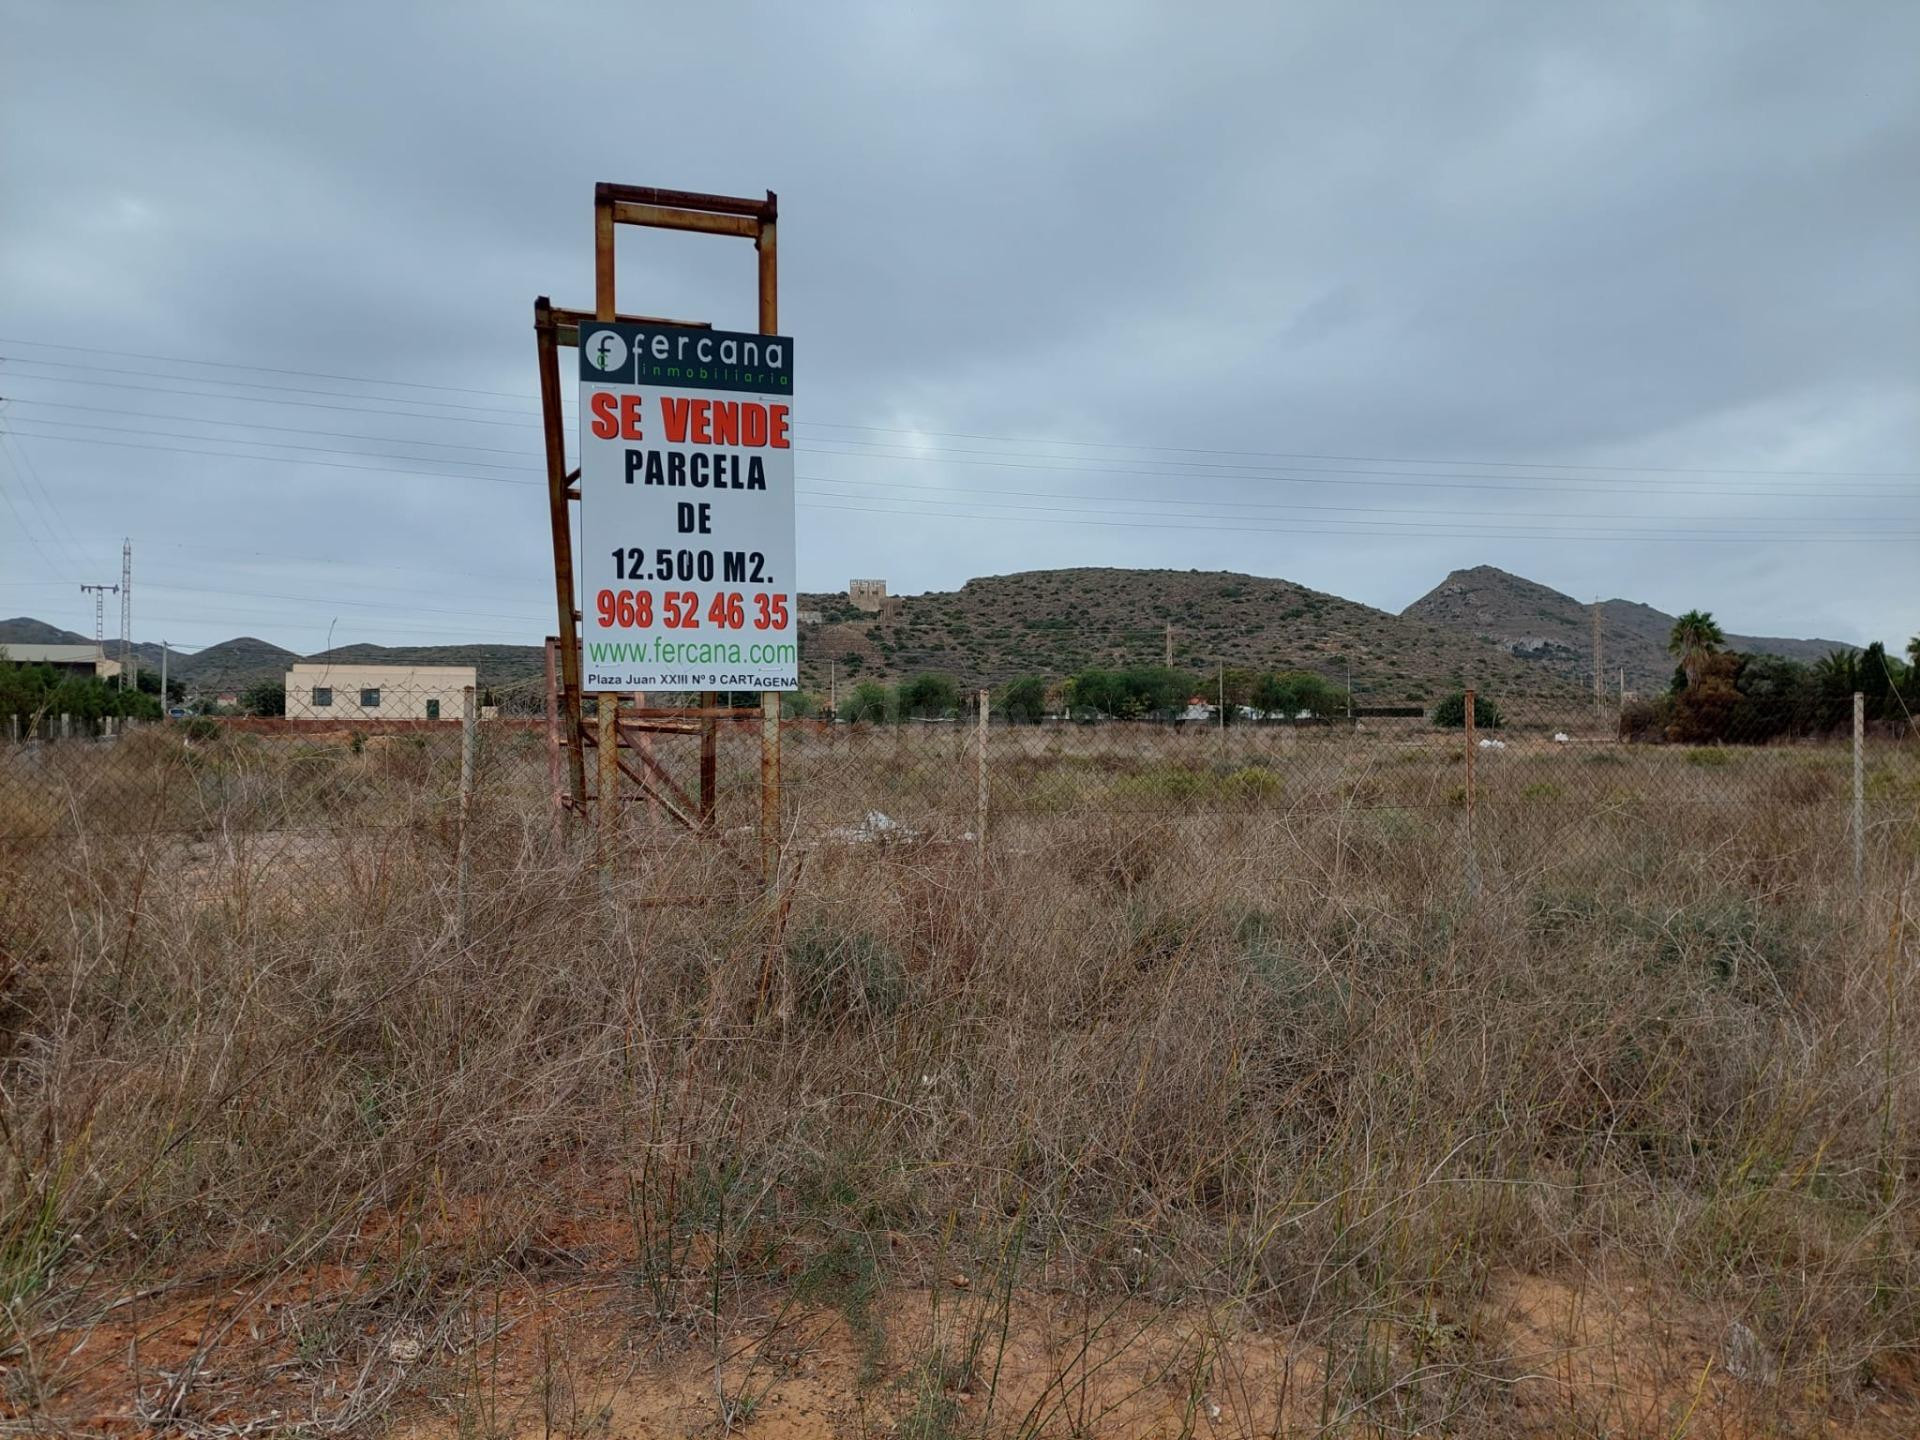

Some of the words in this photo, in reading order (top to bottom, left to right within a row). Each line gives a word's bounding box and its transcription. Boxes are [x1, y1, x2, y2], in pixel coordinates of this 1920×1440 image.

[632, 333, 783, 385] fercana
[642, 363, 788, 386] inmobiliaria
[590, 392, 643, 441] SE
[660, 396, 790, 449] VENDE
[624, 449, 767, 490] PARCELA
[677, 501, 711, 534] DE
[611, 548, 714, 582] 12.500
[723, 551, 774, 583] M2.
[596, 589, 653, 629] 968
[663, 590, 700, 629] 52
[708, 591, 745, 630] 46
[753, 592, 789, 631] 35
[589, 636, 796, 664] www.fercana.com
[588, 674, 622, 685] Plaza
[625, 674, 656, 685] Juan
[660, 674, 688, 685] XXIII
[708, 674, 717, 685] 9
[719, 674, 798, 688] CARTAGENA
